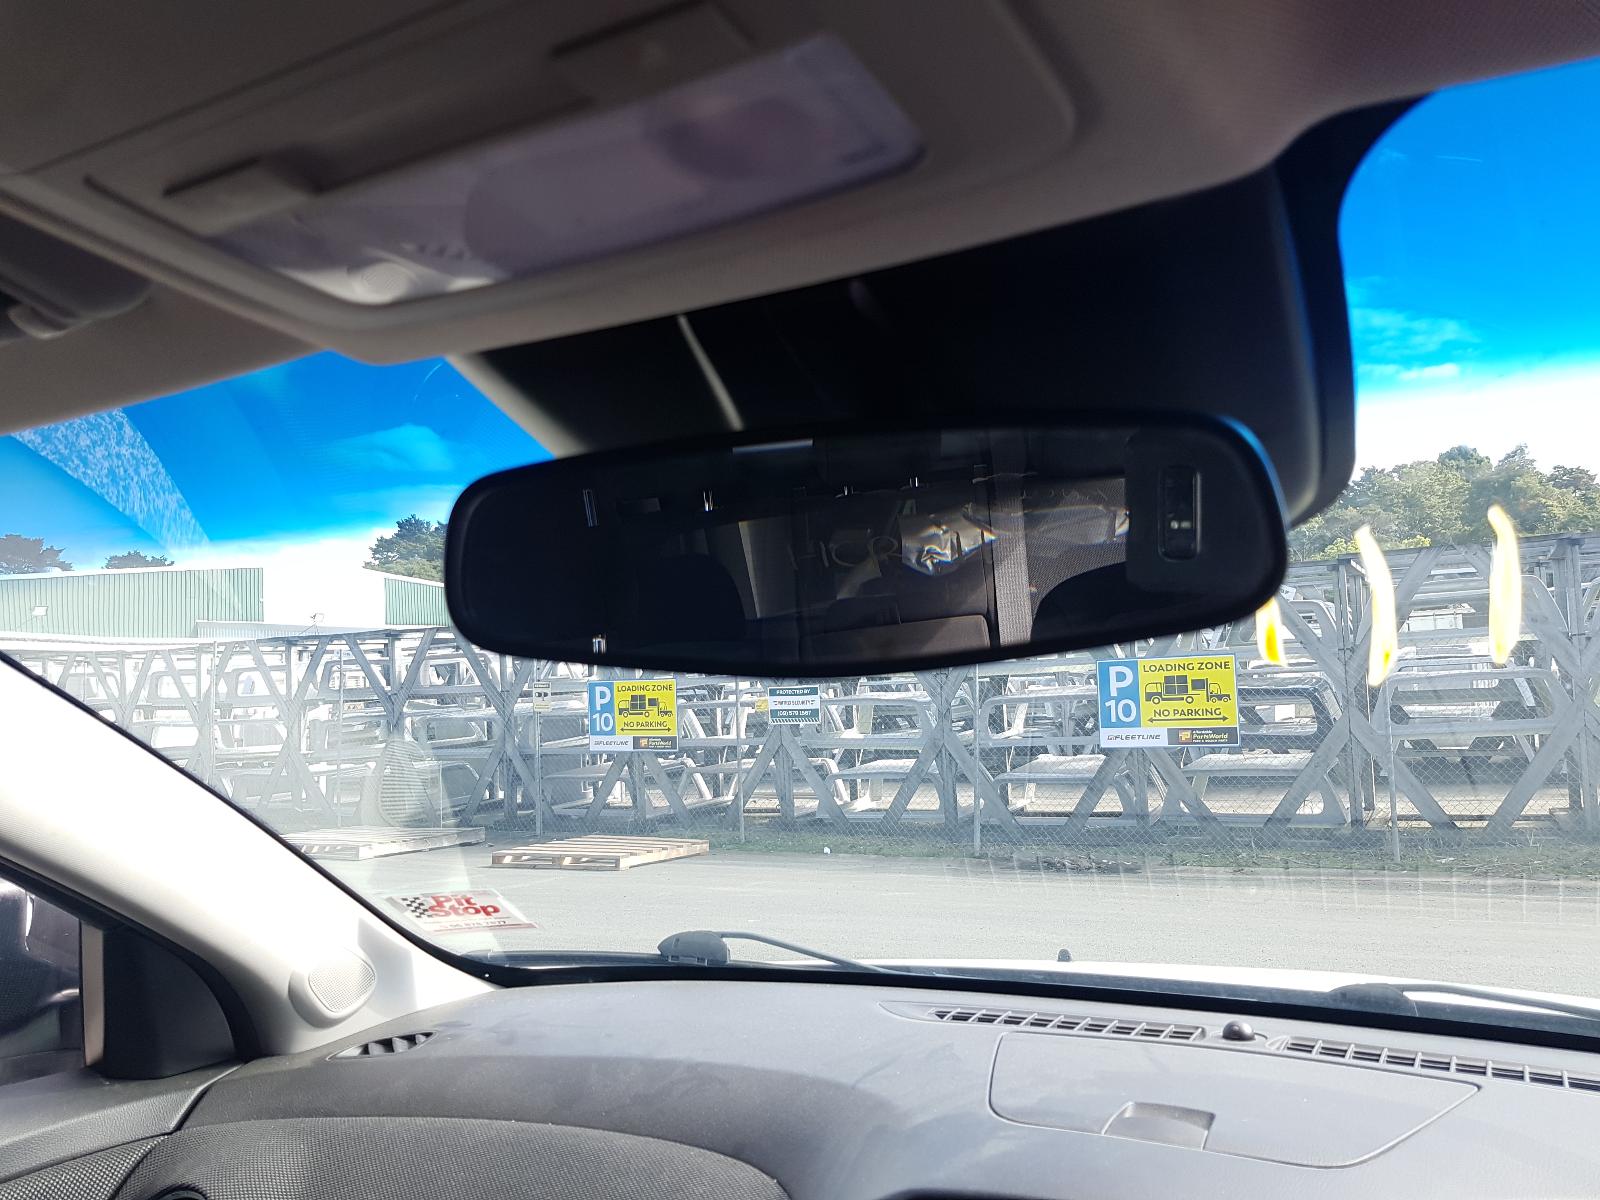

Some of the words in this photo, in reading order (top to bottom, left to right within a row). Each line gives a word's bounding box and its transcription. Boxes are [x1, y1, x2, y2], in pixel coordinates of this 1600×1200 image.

[1143, 662, 1195, 673] LOADING
[1197, 660, 1231, 671] ZONE
[1108, 665, 1134, 697] P
[651, 684, 673, 692] ZONE
[594, 685, 612, 711] P
[1104, 698, 1137, 723] 10
[1153, 708, 1170, 718] NO
[1173, 707, 1222, 717] PARKING
[592, 712, 614, 732] 10
[636, 720, 668, 728] PARKING
[430, 894, 477, 907] Pit
[428, 904, 501, 917] Stop
